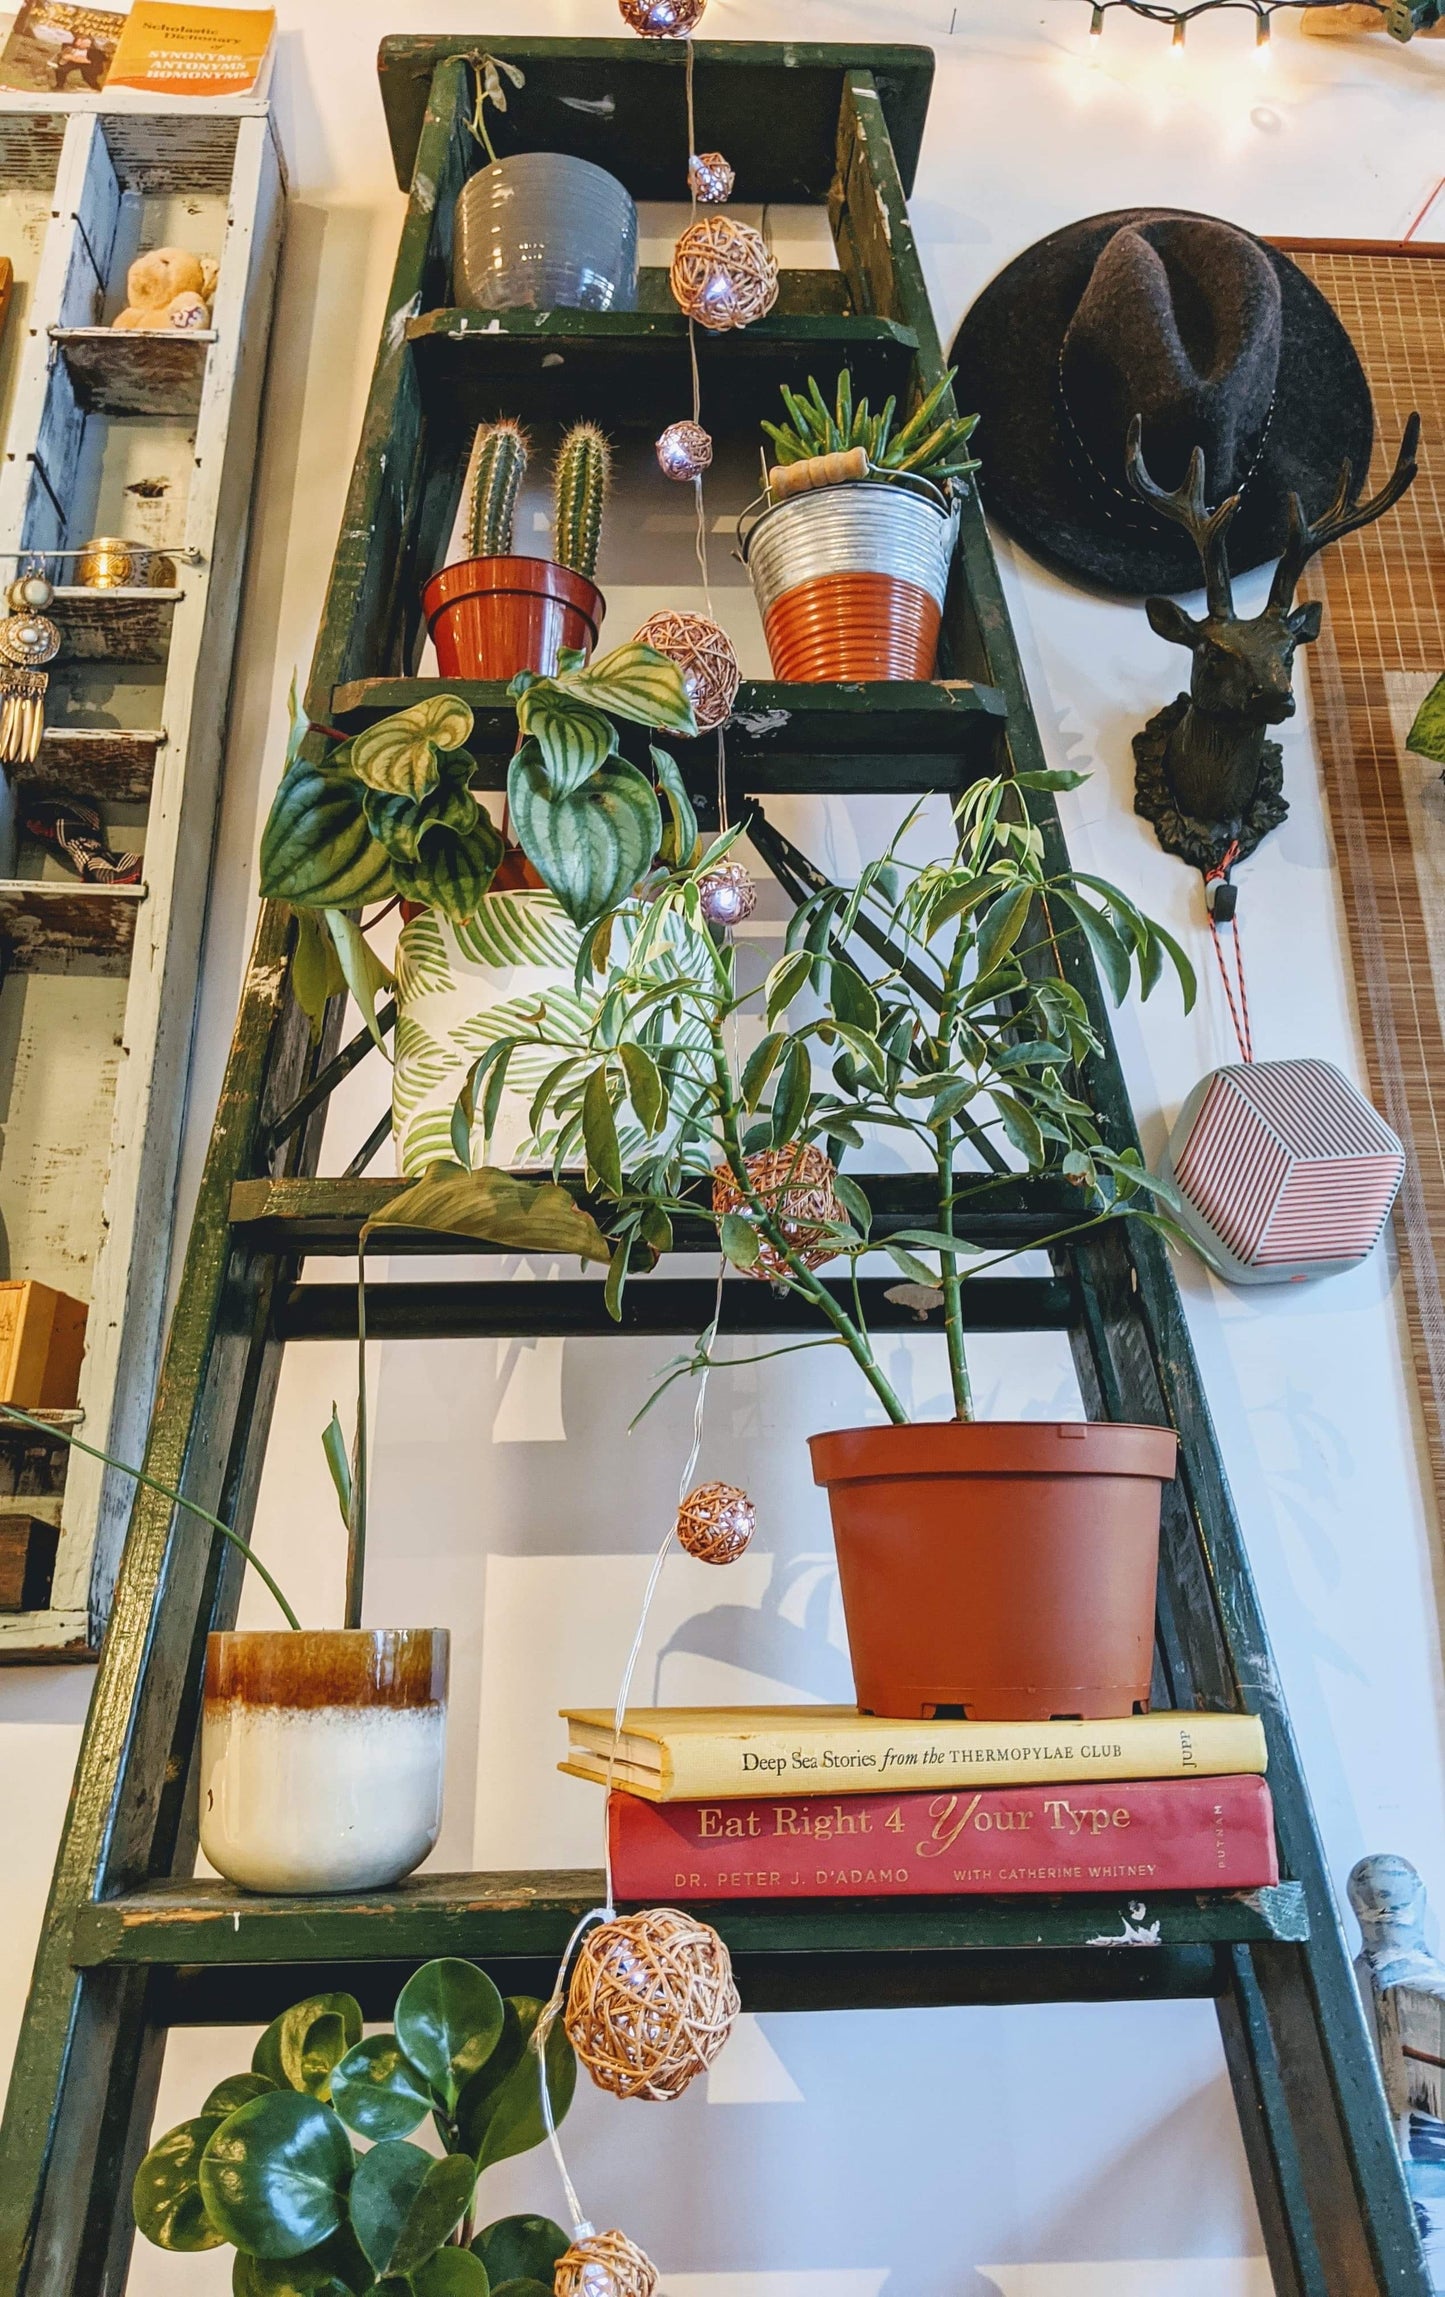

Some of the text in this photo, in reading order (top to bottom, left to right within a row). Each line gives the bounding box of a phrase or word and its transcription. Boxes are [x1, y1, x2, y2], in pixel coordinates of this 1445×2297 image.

[143, 22, 218, 35] Scholastic
[164, 32, 242, 44] Dictionary
[148, 50, 242, 62] SYNONYMS
[150, 60, 247, 71] ANTONYMS
[146, 70, 250, 80] HOMONYMS
[1180, 1730, 1197, 1768] JUPP
[742, 1744, 1122, 1776] Deep Sea Stories from the THERMOPYLAE CLUB
[697, 1793, 1131, 1859] Eat Right 4 Your Type
[1213, 1804, 1227, 1870] PUTNAM
[674, 1868, 909, 1888] DR. PETER J. D'ADAMO
[953, 1864, 1157, 1881] WITH CATHERINE WHITNEY
